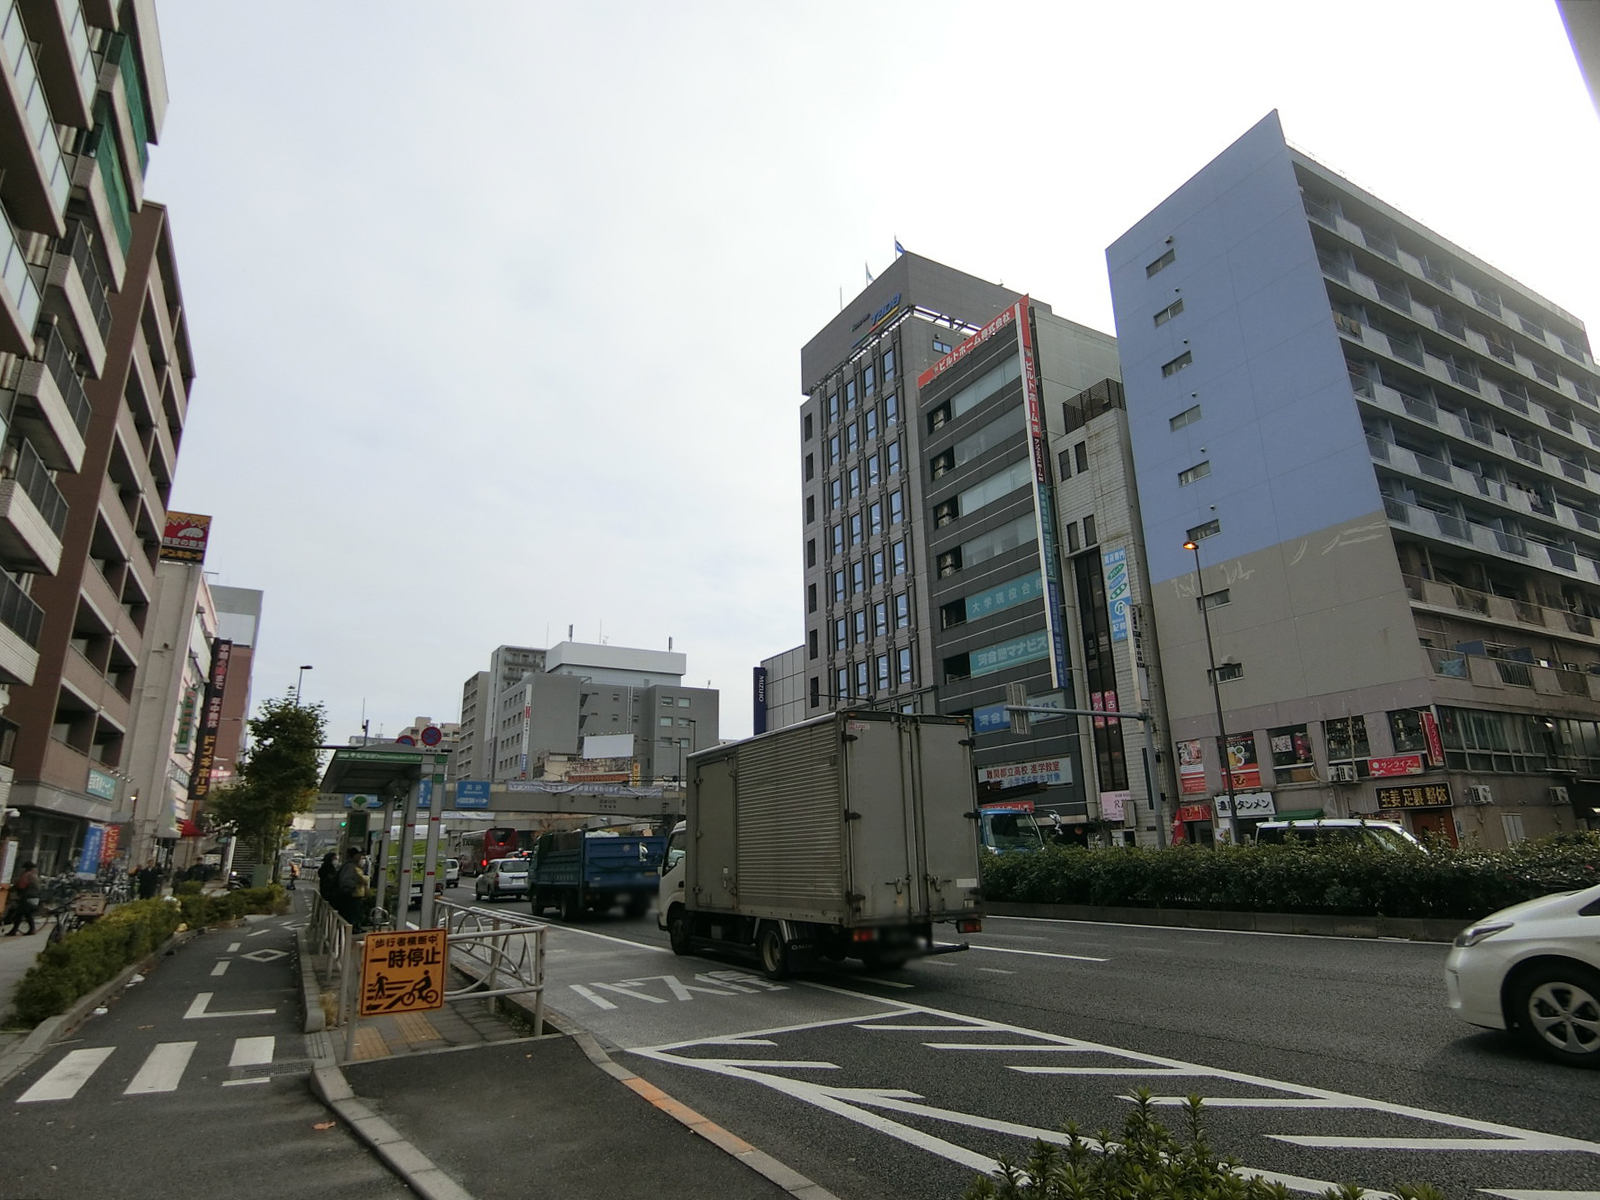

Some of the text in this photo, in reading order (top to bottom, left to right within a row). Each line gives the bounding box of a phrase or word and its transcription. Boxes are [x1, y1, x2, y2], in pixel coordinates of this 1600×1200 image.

[939, 311, 1010, 371] ビルトホーム株式会社
[1030, 760, 1060, 775] 進学教室
[1380, 759, 1413, 769] サンライズ
[1380, 786, 1448, 808] 生姜 足裏 整体
[1217, 799, 1270, 812] 濃タンメン
[375, 935, 438, 948] 歩行者横断中
[369, 946, 441, 968] 一時停止
